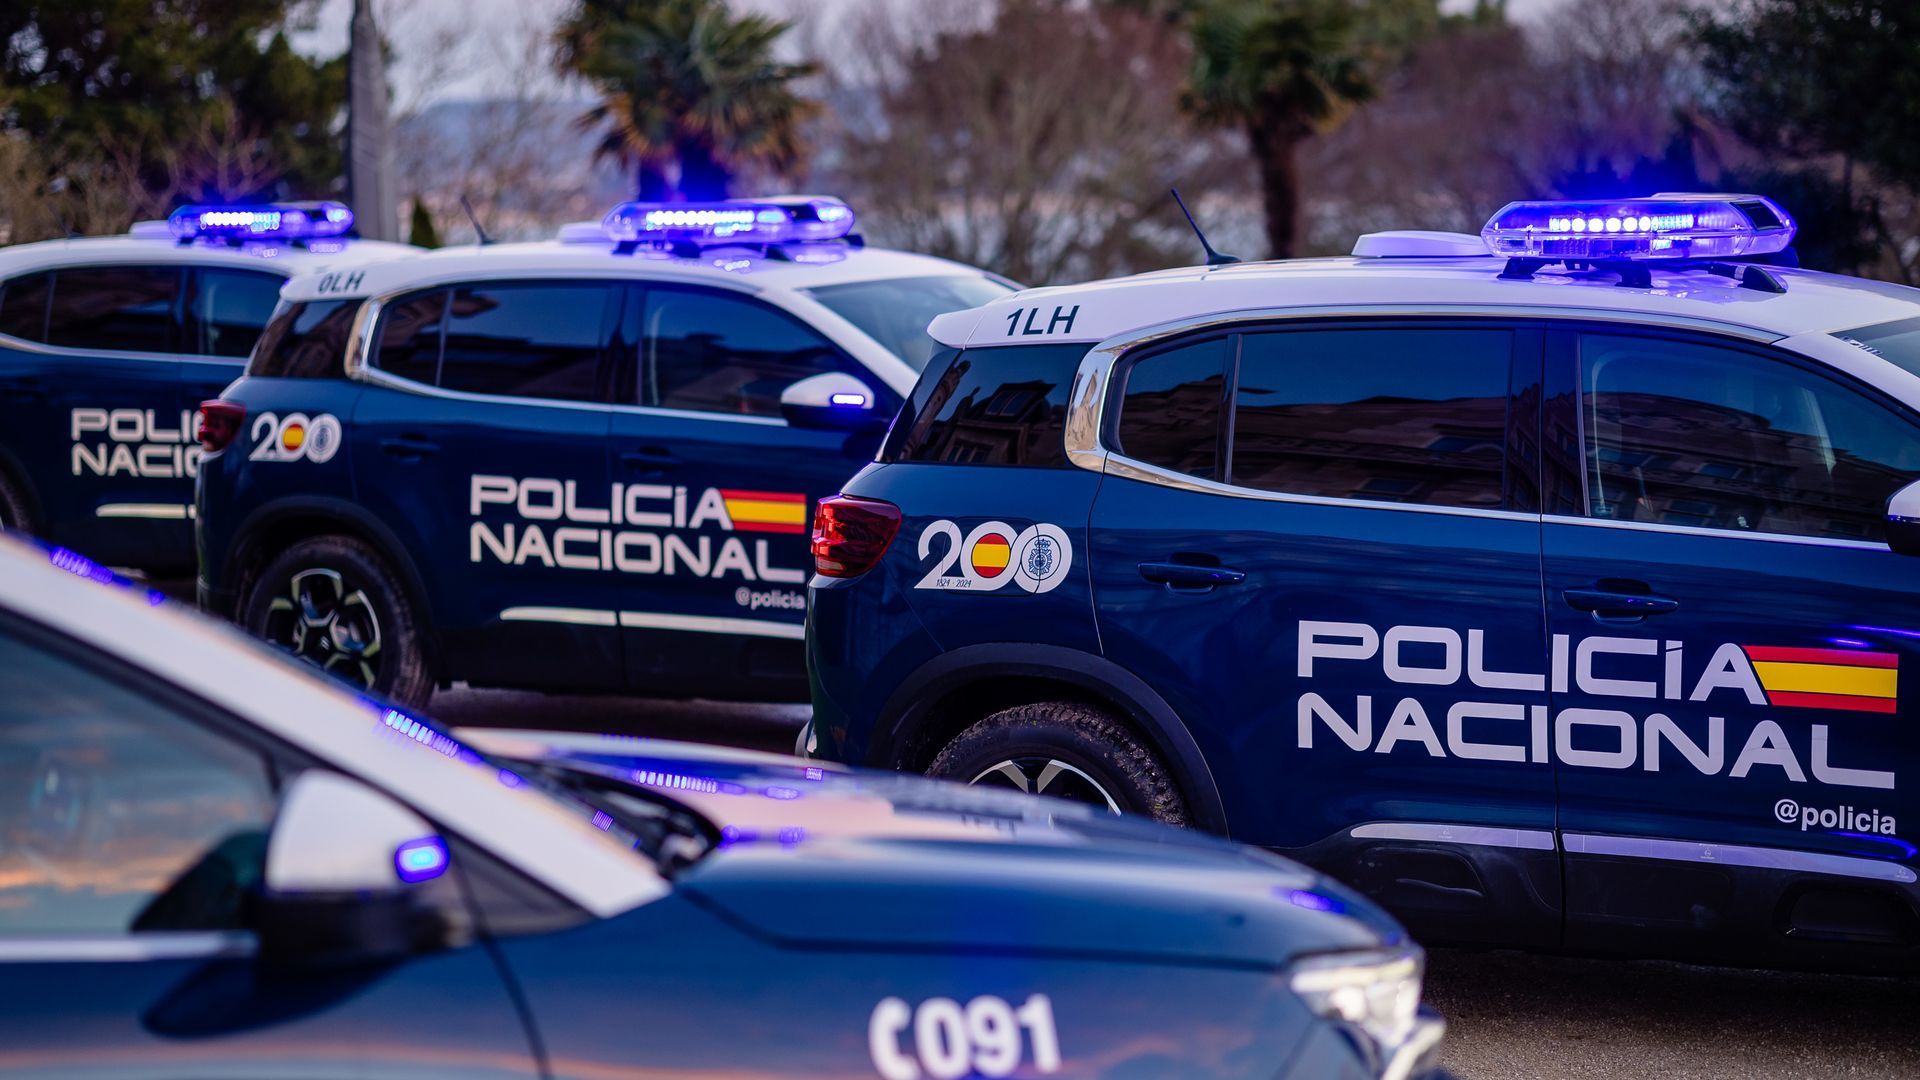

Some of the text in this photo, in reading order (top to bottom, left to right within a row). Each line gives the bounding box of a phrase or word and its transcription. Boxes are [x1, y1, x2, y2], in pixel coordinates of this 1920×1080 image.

[1007, 305, 1080, 336] 1LH
[248, 411, 342, 464] 200
[470, 522, 806, 584] NACIONAL
[914, 519, 1073, 594] 200
[735, 586, 806, 610] @policia
[956, 579, 972, 588] 2024
[1297, 692, 1895, 789] NACIONAL
[1774, 799, 1896, 835] @policia
